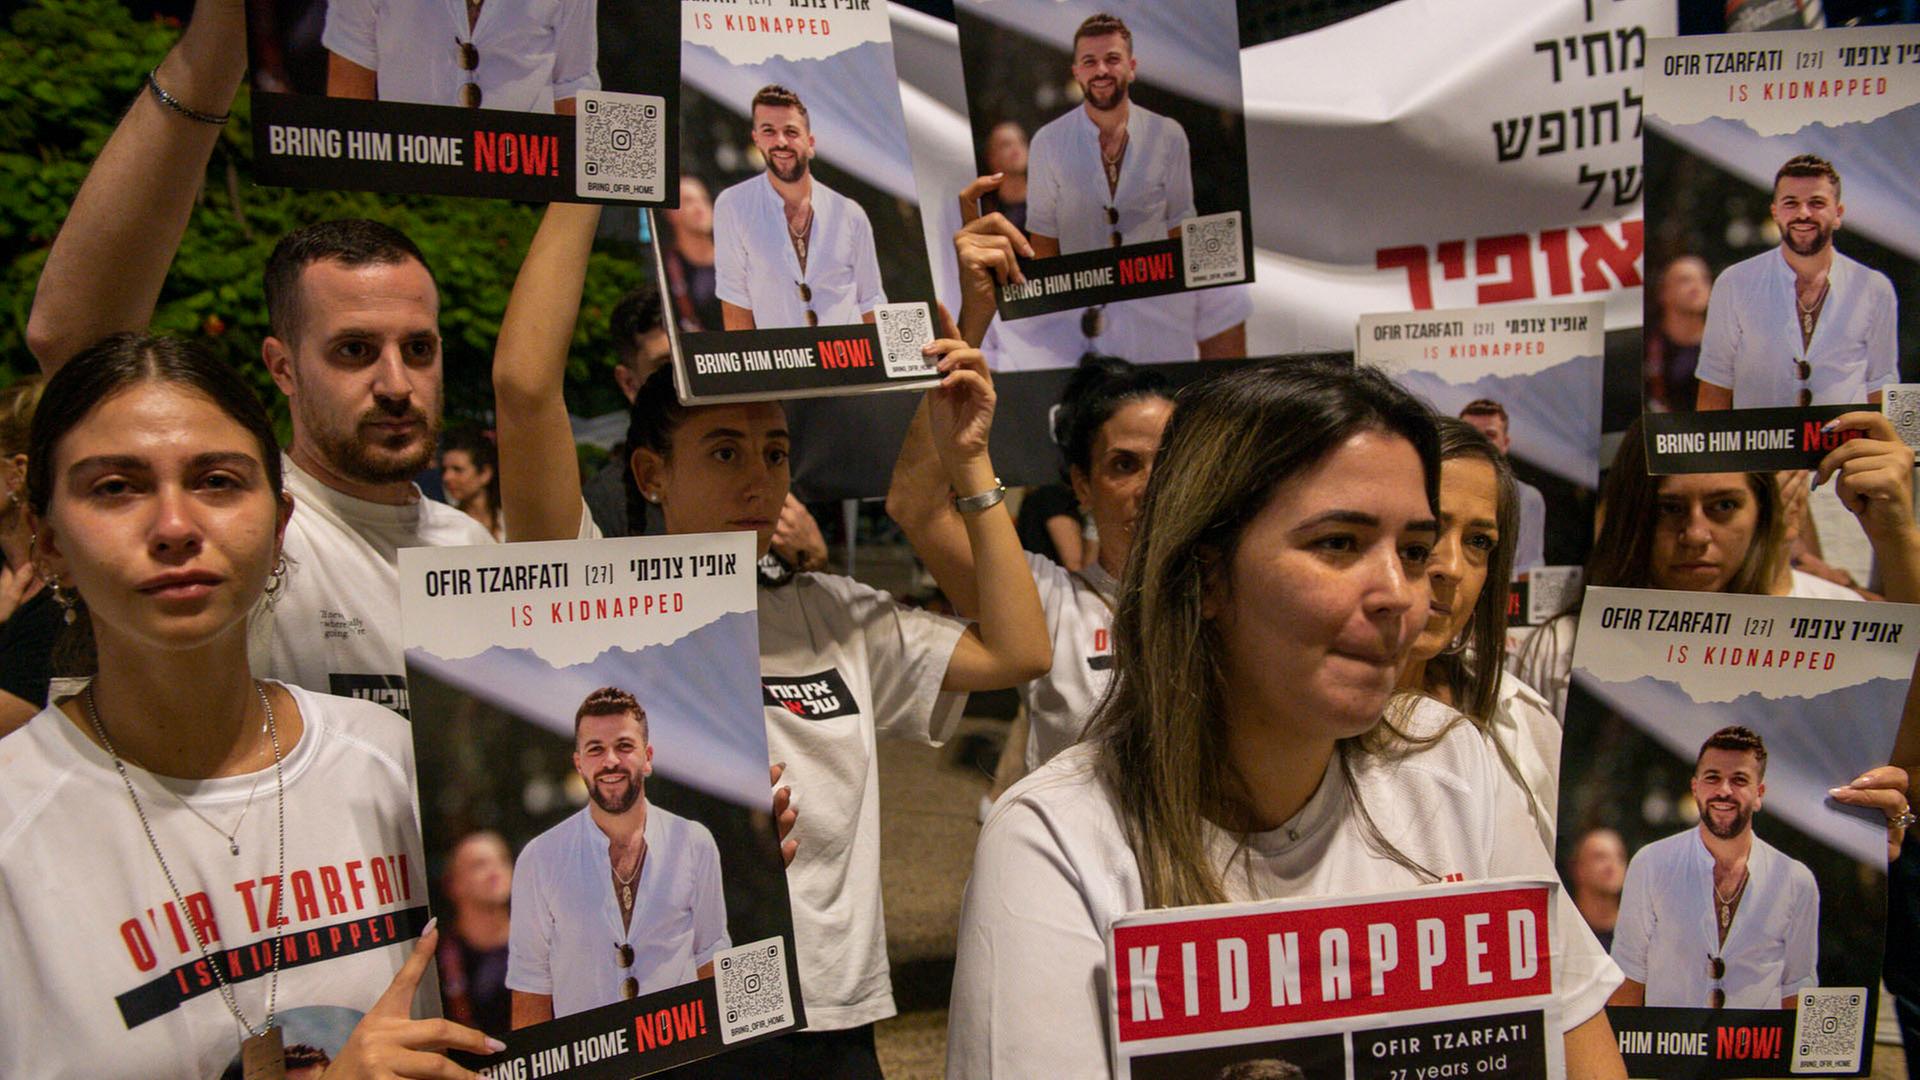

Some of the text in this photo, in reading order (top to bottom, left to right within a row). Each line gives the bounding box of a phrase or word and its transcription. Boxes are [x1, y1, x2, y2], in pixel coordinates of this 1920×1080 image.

[695, 13, 831, 36] IS KIDNAPPED
[1534, 25, 1646, 82] מחיר
[1664, 54, 1700, 76] OFIR
[1705, 50, 1783, 74] TZARFATI
[1729, 77, 1888, 102] IS KIDNAPPED
[1493, 87, 1643, 163] לחופש
[269, 125, 560, 177] BRING HIM HOME NOW!
[1578, 164, 1643, 211] של
[1045, 272, 1072, 296] HIM
[1074, 266, 1114, 292] HOME
[1118, 252, 1175, 285] NOW!
[1376, 219, 1643, 311] אופיר
[1374, 324, 1402, 341] OFIR
[1404, 321, 1463, 340] TZARFATI
[694, 338, 875, 375] BRING HIM HOME NOW!
[1424, 341, 1546, 359] IS KIDNAPPED
[1656, 433, 1705, 454] BRING
[1709, 431, 1741, 452] HIM
[1745, 428, 1795, 451] HOME
[425, 568, 472, 597] OFIR
[476, 562, 569, 594] TZARFATI
[630, 553, 737, 582] אופיר צרפתי
[511, 592, 684, 628] IS KIDNAPPED
[1601, 607, 1642, 631] OFIR
[1647, 609, 1732, 635] TZARFATI
[1789, 617, 1904, 643] אופיר צרפתי
[1667, 644, 1836, 670] IS KIDNAPPED
[120, 891, 221, 973] OIR
[175, 915, 396, 995] IS KIDNAPPED
[1128, 908, 1539, 1022] KIDNAPPED
[531, 1045, 569, 1079] HIM
[573, 1028, 629, 1067] HOME
[635, 998, 708, 1053] NOW!
[1372, 1024, 1528, 1058] OFIR TZARFATI
[1618, 1026, 1782, 1060] HIM HOME NOW!
[1416, 1060, 1469, 1080] years
[1476, 1054, 1507, 1073] old
